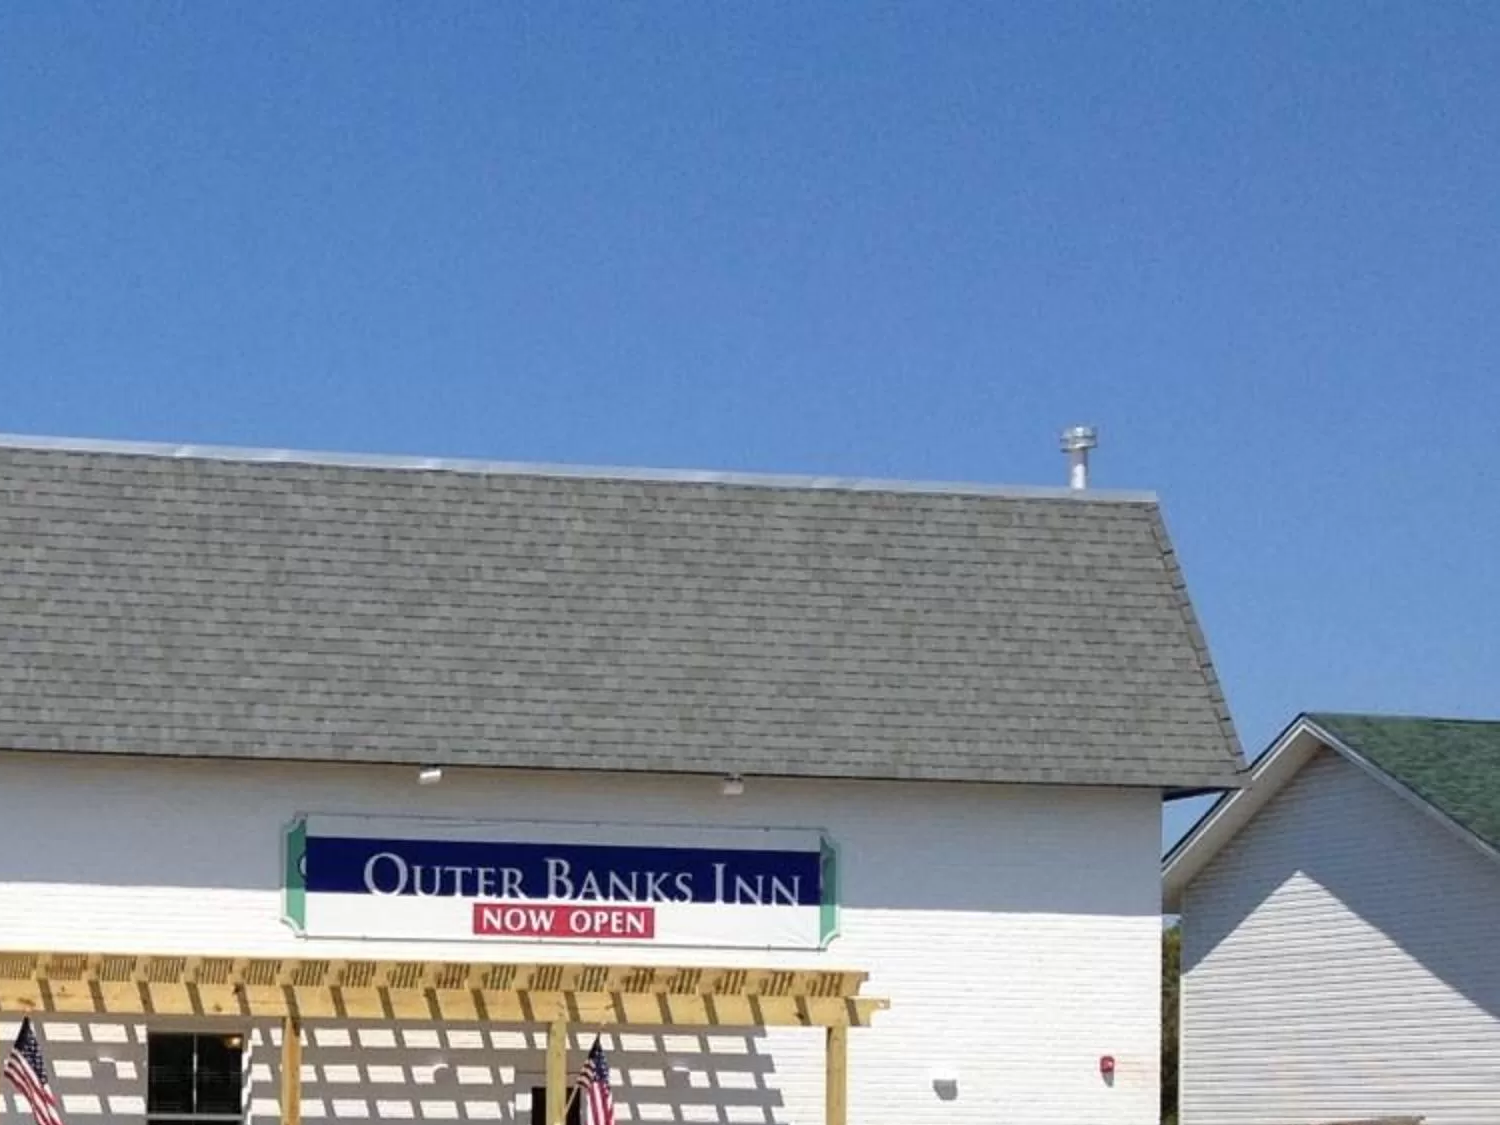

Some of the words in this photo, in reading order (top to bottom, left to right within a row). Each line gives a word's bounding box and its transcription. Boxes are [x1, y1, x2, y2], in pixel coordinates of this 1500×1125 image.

[363, 852, 529, 899] OUTER
[544, 857, 694, 904] BANKS
[711, 862, 802, 907] INN
[482, 907, 556, 932] NOW
[569, 910, 646, 935] OPEN
